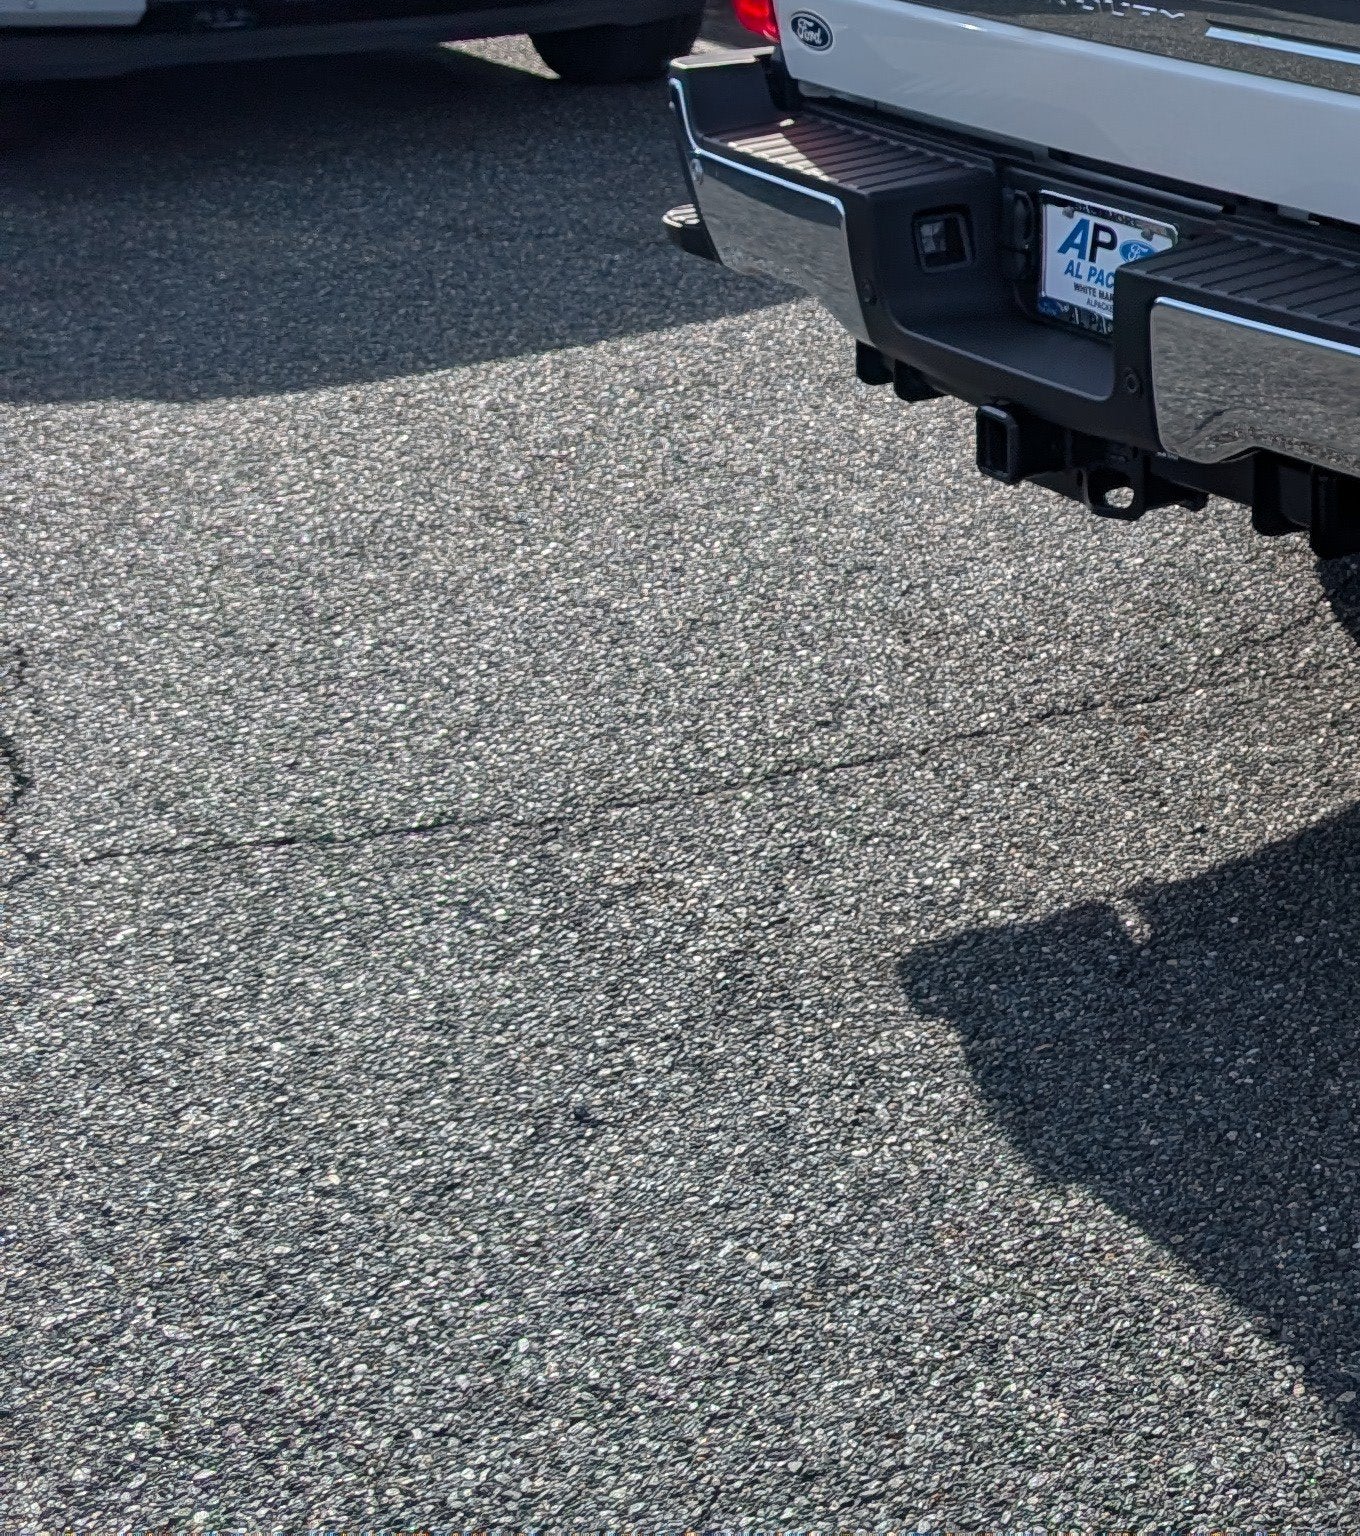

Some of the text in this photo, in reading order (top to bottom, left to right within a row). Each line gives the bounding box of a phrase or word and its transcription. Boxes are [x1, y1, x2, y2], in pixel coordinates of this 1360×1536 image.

[797, 18, 822, 44] Ford
[1058, 218, 1118, 263] AP
[1064, 259, 1083, 279] AL
